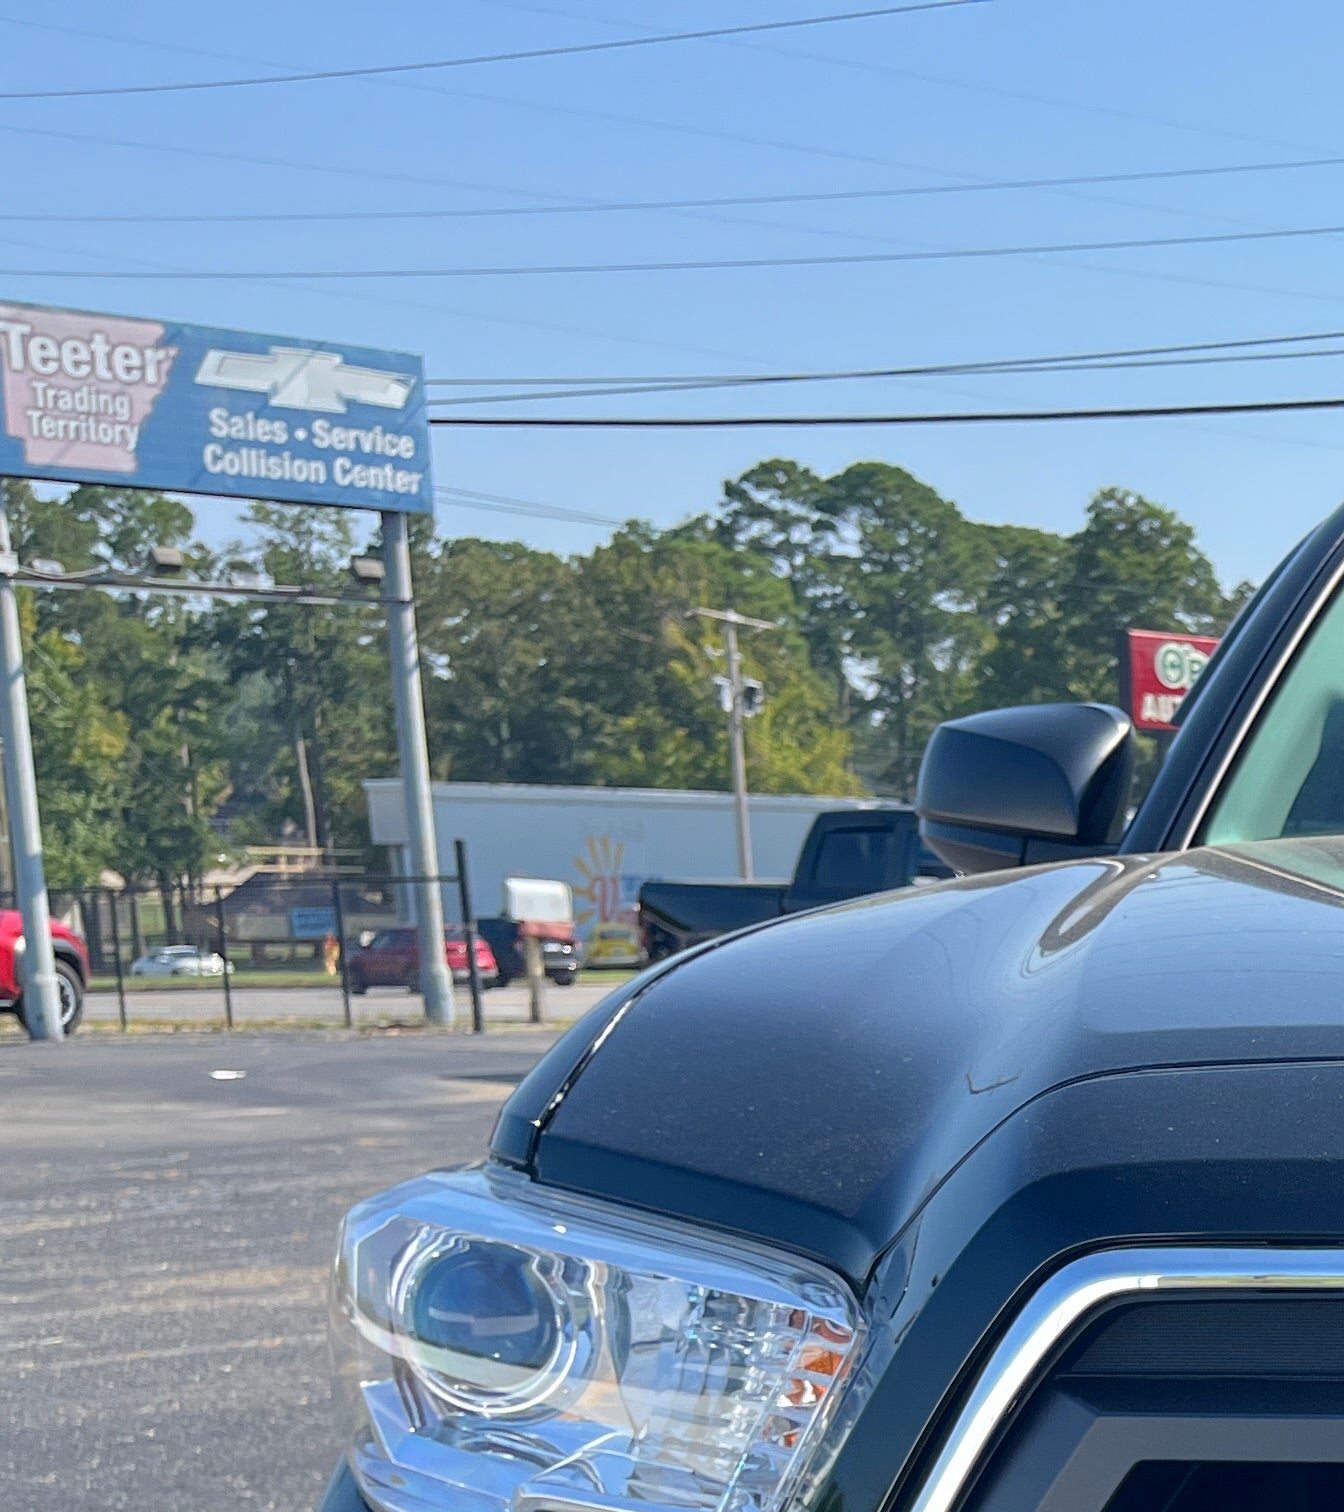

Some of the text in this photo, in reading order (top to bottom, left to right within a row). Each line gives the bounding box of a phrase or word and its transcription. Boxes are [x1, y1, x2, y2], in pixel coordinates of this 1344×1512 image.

[0, 320, 167, 385] Teeter
[31, 380, 131, 421] Trading
[27, 410, 139, 451] Territory
[209, 407, 416, 460] Sales Service
[203, 443, 423, 494] Collision Center
